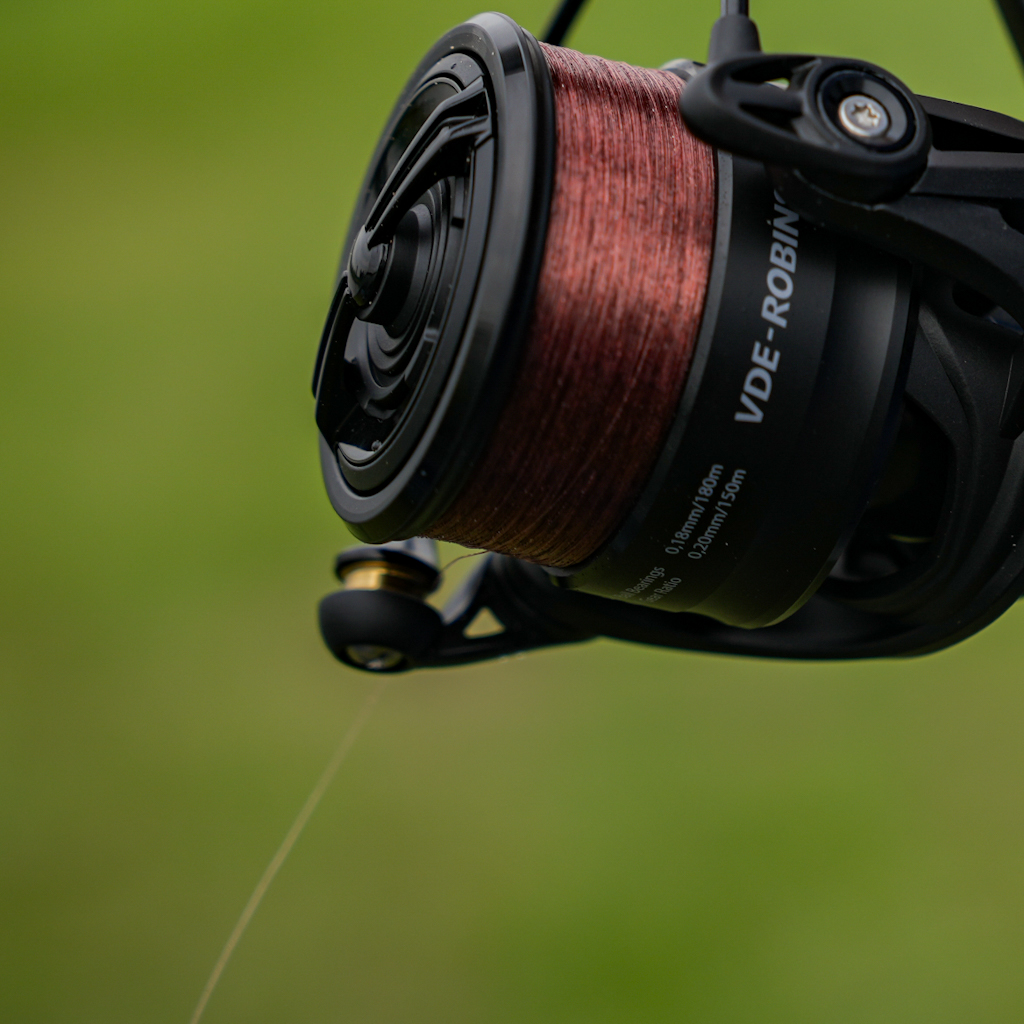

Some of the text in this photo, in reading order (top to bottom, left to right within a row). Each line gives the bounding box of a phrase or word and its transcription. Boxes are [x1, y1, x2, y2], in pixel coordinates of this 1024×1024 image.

[733, 188, 800, 424] VDE-ROBIN
[664, 463, 725, 555] 0,18mm/180m
[687, 468, 748, 560] 0,20mm/150m
[627, 566, 666, 595] Bearings
[654, 576, 683, 598] Ratio
